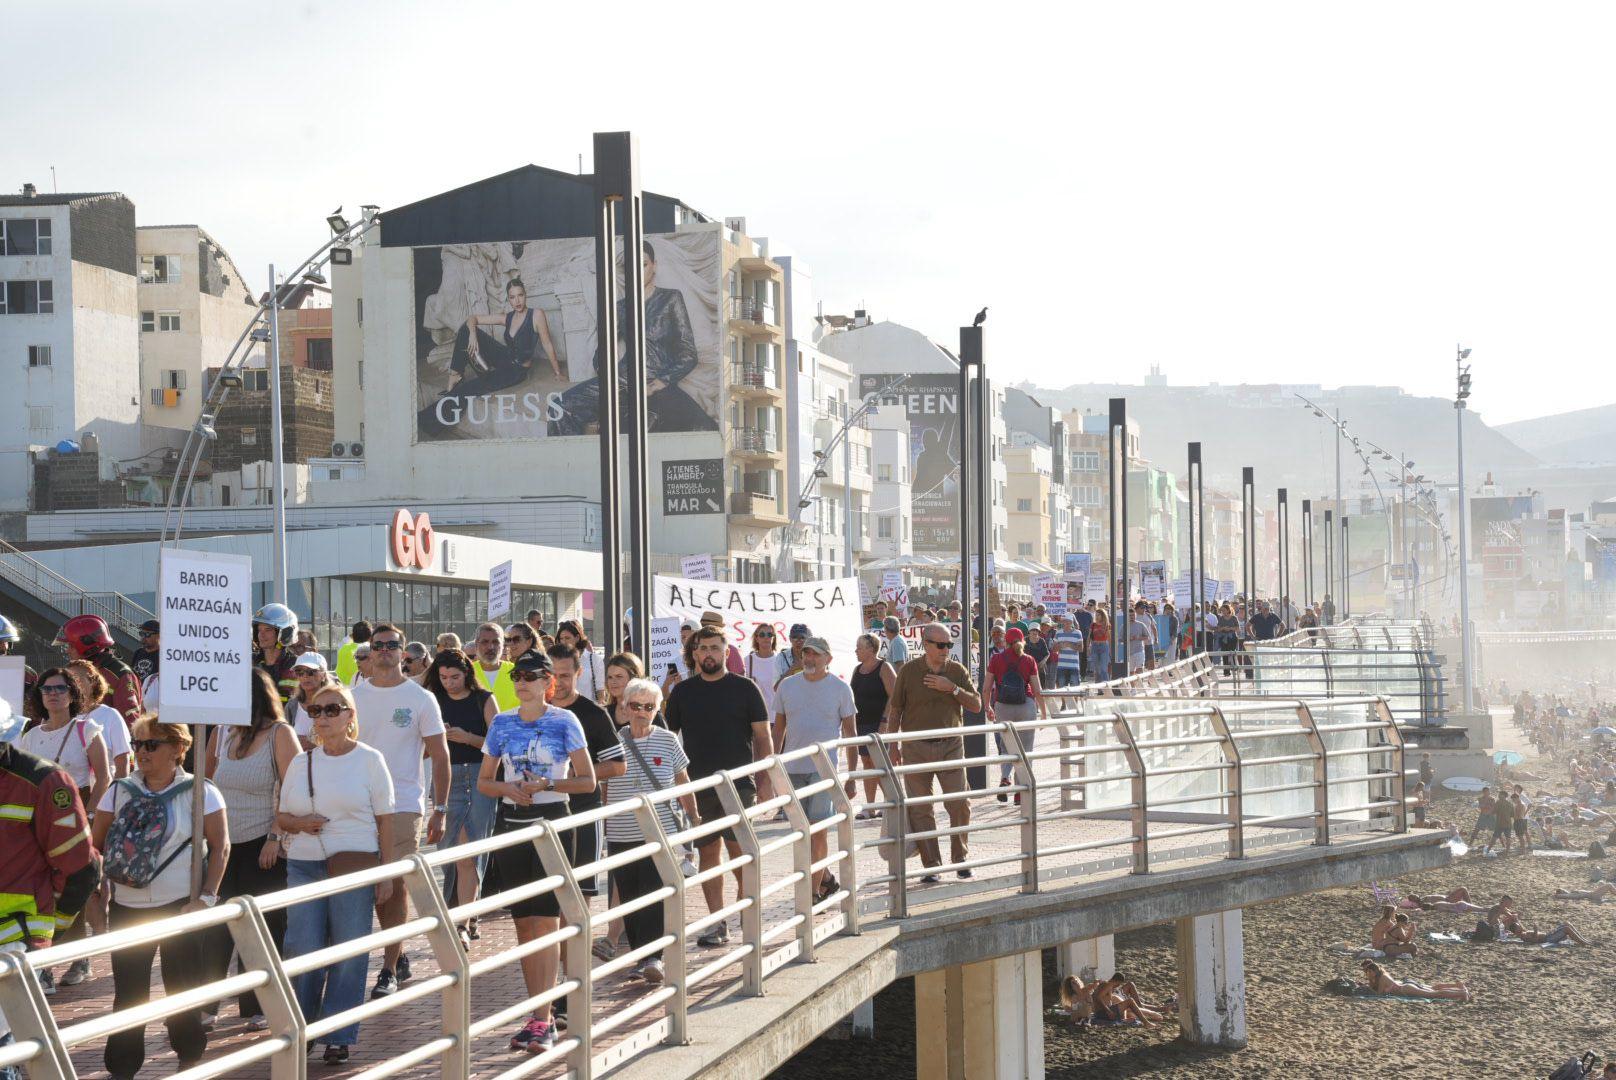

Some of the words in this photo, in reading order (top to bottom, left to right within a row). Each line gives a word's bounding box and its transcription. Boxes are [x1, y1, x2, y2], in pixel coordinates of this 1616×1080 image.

[435, 392, 564, 426] GUESS
[666, 465, 700, 474] ¿TIENES
[666, 472, 705, 481] HAMBRE?
[668, 497, 700, 512] MAR
[391, 508, 436, 570] GO
[180, 571, 228, 588] BARRIO
[166, 596, 242, 615] MARZAGÁN
[178, 623, 230, 640] UNIDOS
[650, 626, 669, 635] RRIO
[651, 636, 677, 647] ZAGÁN
[166, 648, 210, 663] SOMOS
[213, 649, 241, 665] MÁS
[180, 675, 219, 692] LPGC
